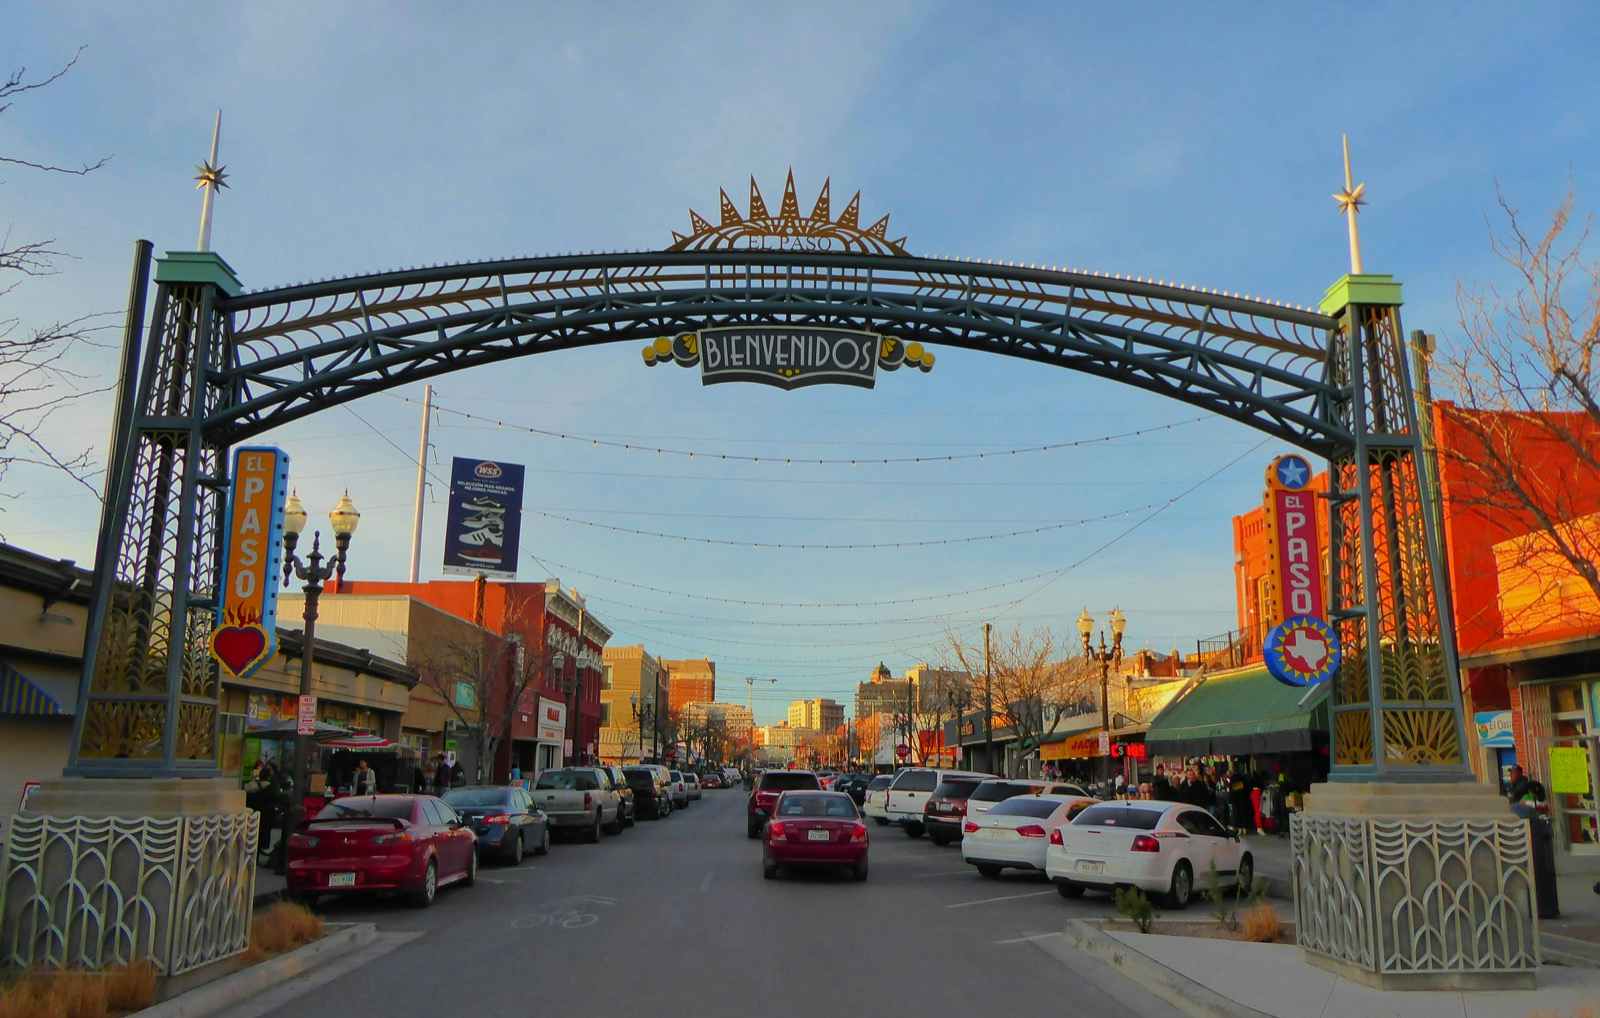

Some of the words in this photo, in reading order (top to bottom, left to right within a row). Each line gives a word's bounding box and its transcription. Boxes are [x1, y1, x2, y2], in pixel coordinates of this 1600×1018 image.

[748, 237, 773, 250] EL
[780, 237, 832, 251] PASO
[705, 334, 872, 371] BIENVENIDOS
[245, 456, 266, 473] EL
[1285, 496, 1304, 508] EL
[235, 477, 265, 599] PASO
[1285, 512, 1312, 614] PASO
